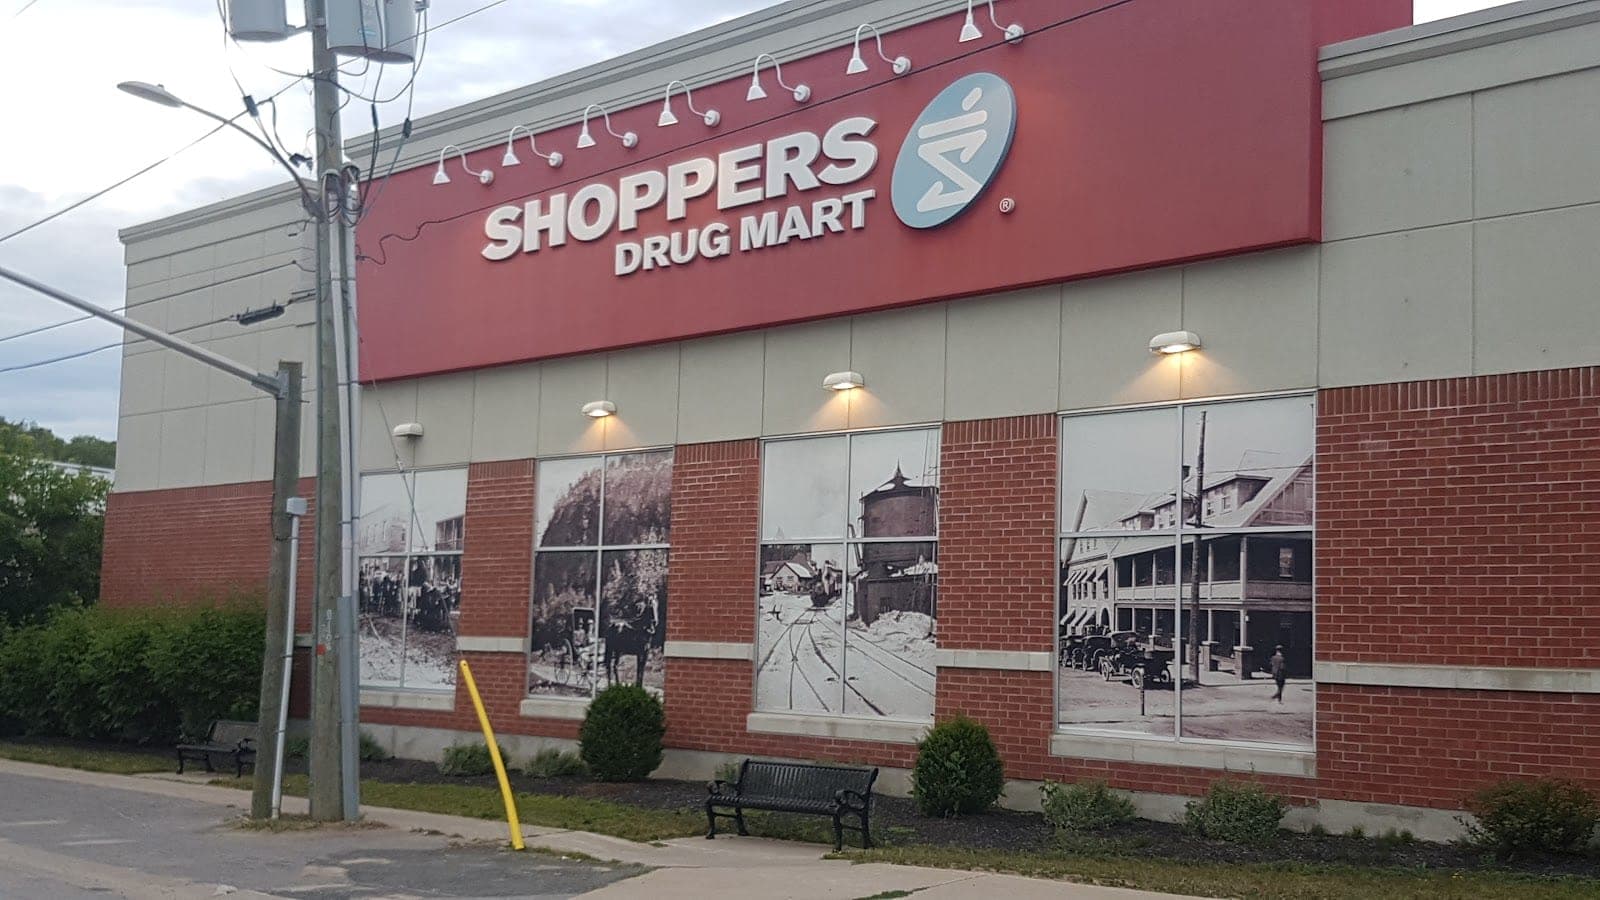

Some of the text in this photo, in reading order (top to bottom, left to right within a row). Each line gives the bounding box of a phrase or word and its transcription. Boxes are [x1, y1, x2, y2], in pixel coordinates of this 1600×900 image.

[482, 117, 878, 261] SHOPPERS
[615, 190, 876, 276] DRUG MART
